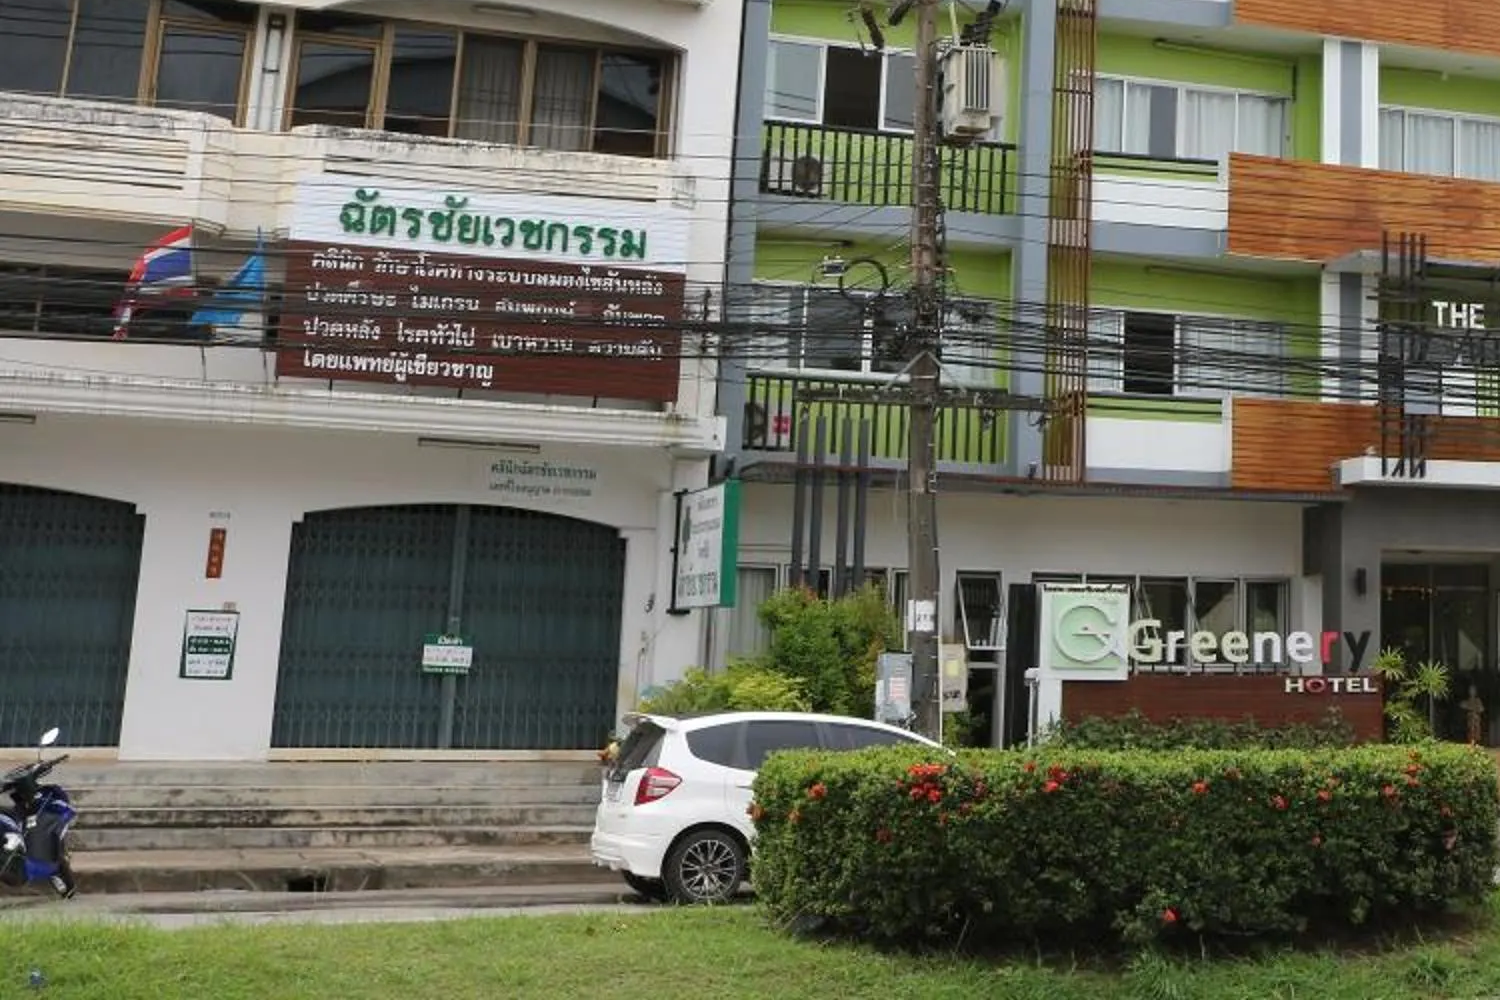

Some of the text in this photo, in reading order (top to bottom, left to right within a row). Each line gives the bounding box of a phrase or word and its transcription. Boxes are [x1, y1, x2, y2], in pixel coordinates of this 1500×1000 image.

[339, 188, 647, 260] ฉัตรชัยเวชกรรม
[1432, 301, 1486, 330] THE
[1127, 619, 1372, 673] Greenery
[1284, 677, 1379, 694] HOTEL
